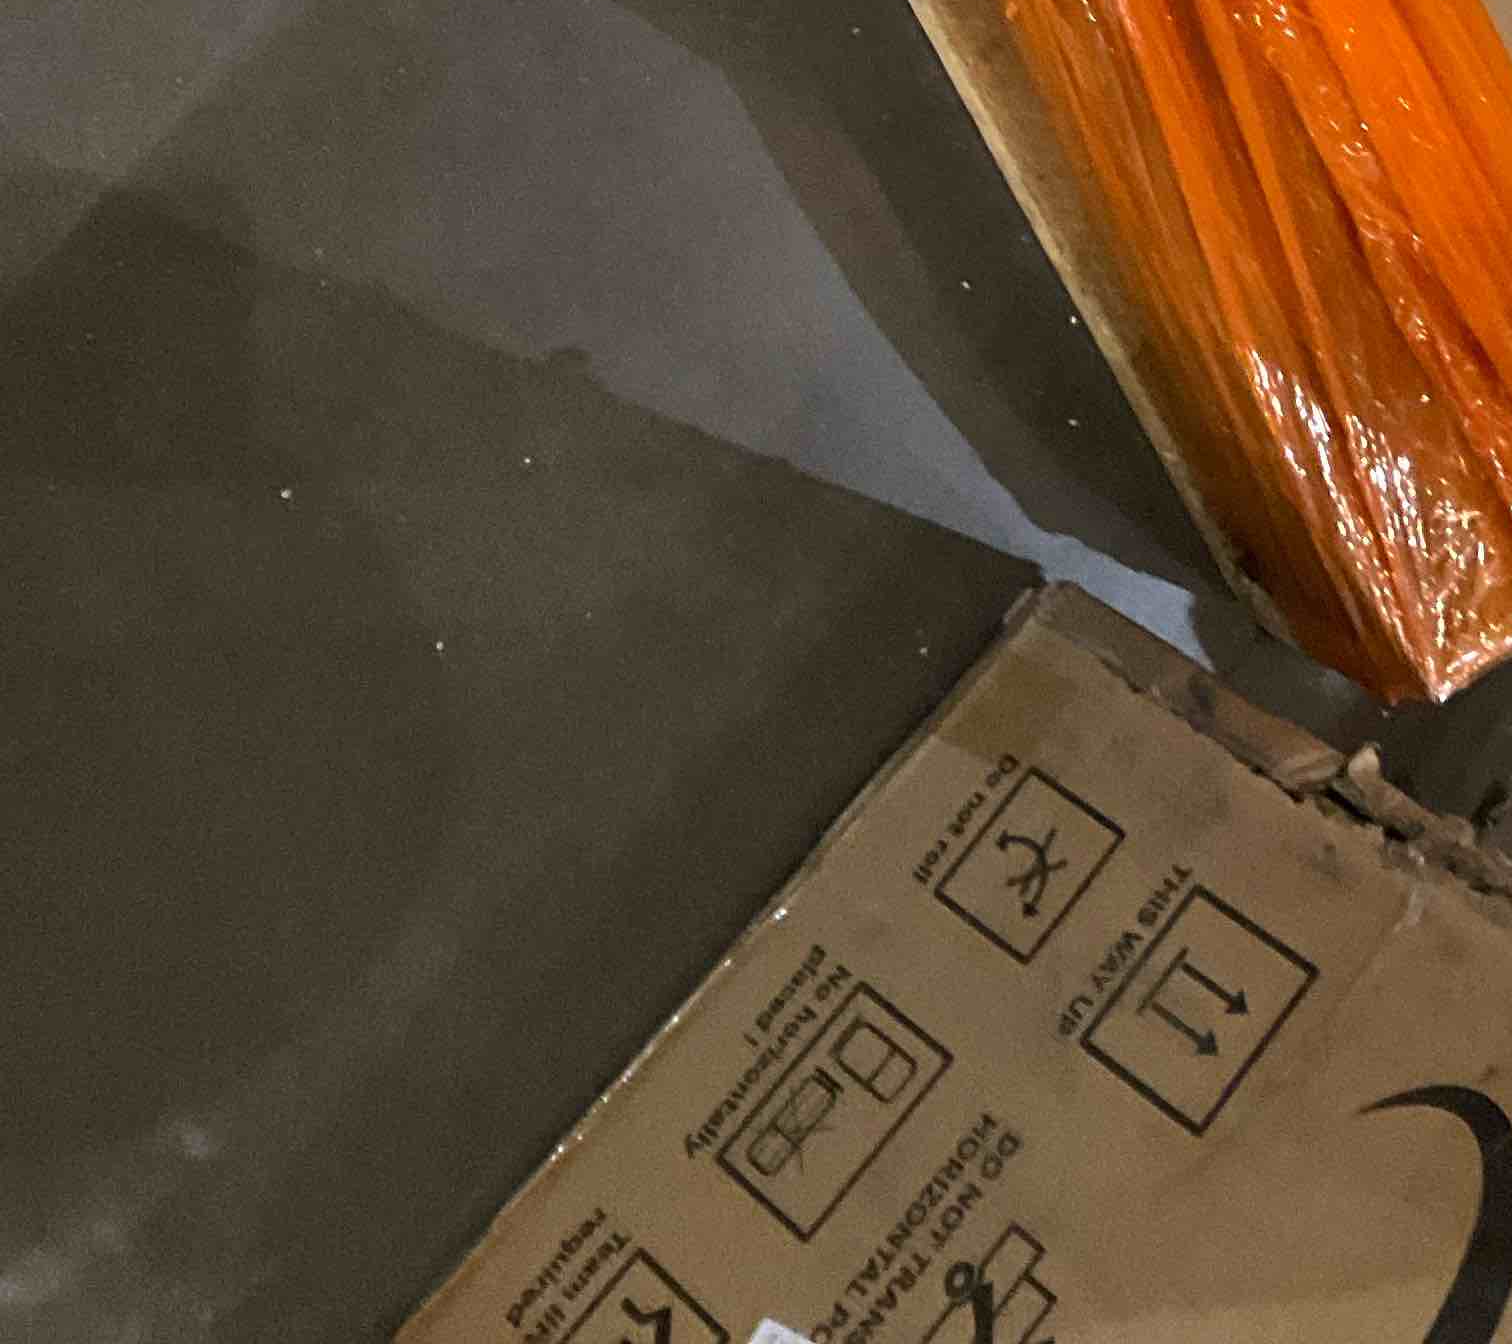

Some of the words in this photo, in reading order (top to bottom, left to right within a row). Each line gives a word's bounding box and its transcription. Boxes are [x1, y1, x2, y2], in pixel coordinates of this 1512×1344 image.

[986, 754, 1020, 788] Do
[947, 791, 987, 838] not
[912, 839, 949, 886] roll
[1137, 864, 1193, 927] THIS
[816, 964, 853, 1001] No
[1090, 931, 1145, 994] WAY
[1057, 994, 1095, 1036] UP
[981, 1130, 1021, 1180] DO
[845, 1113, 997, 1297] HORIZONTAL
[929, 1183, 983, 1252] NOT
[561, 1232, 632, 1301] Team
